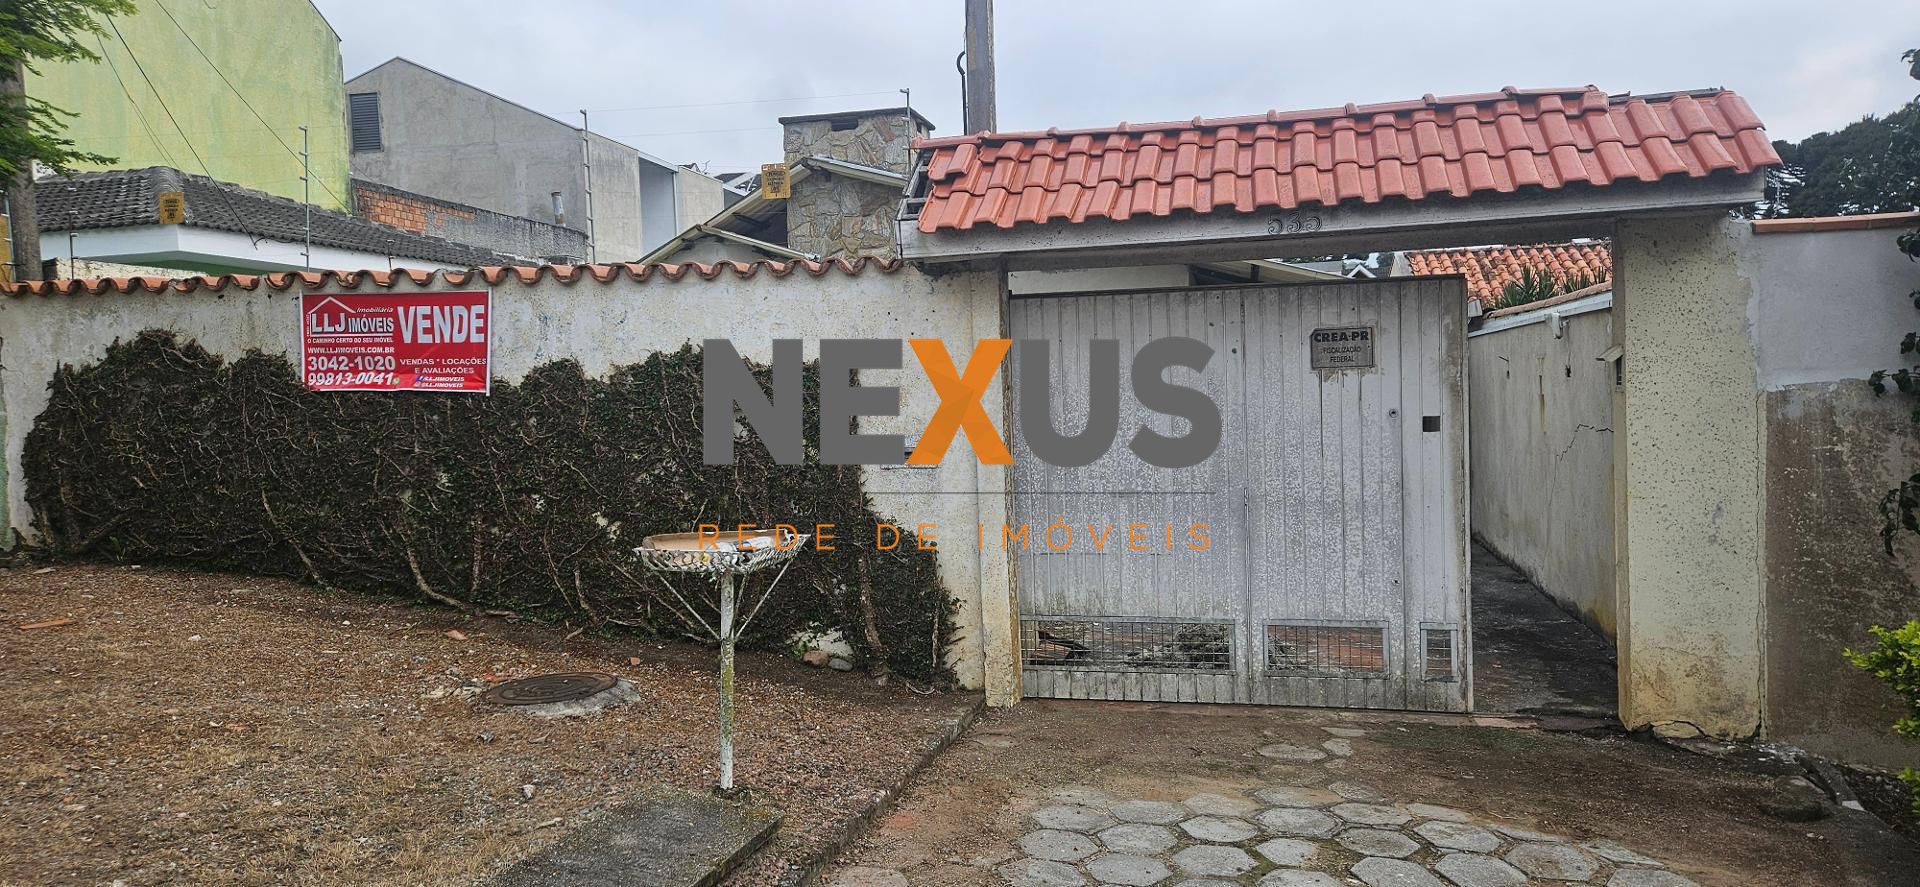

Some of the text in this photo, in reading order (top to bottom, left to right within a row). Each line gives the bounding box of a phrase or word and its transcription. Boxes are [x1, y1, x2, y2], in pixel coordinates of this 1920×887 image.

[312, 313, 346, 332] LLJ
[348, 314, 394, 333] IMÓVEIS
[397, 305, 485, 343] VENDE
[1313, 330, 1369, 343] CREA-PR
[307, 346, 395, 354] WWW.LLJIMOVEIS.COM.BR
[307, 355, 396, 371] 3042-1020
[441, 357, 487, 366] LOCAÇÕES
[1329, 355, 1354, 363] FEDERAL
[422, 366, 474, 375] AVALIAÇÕES
[307, 371, 395, 386] 99813-0041
